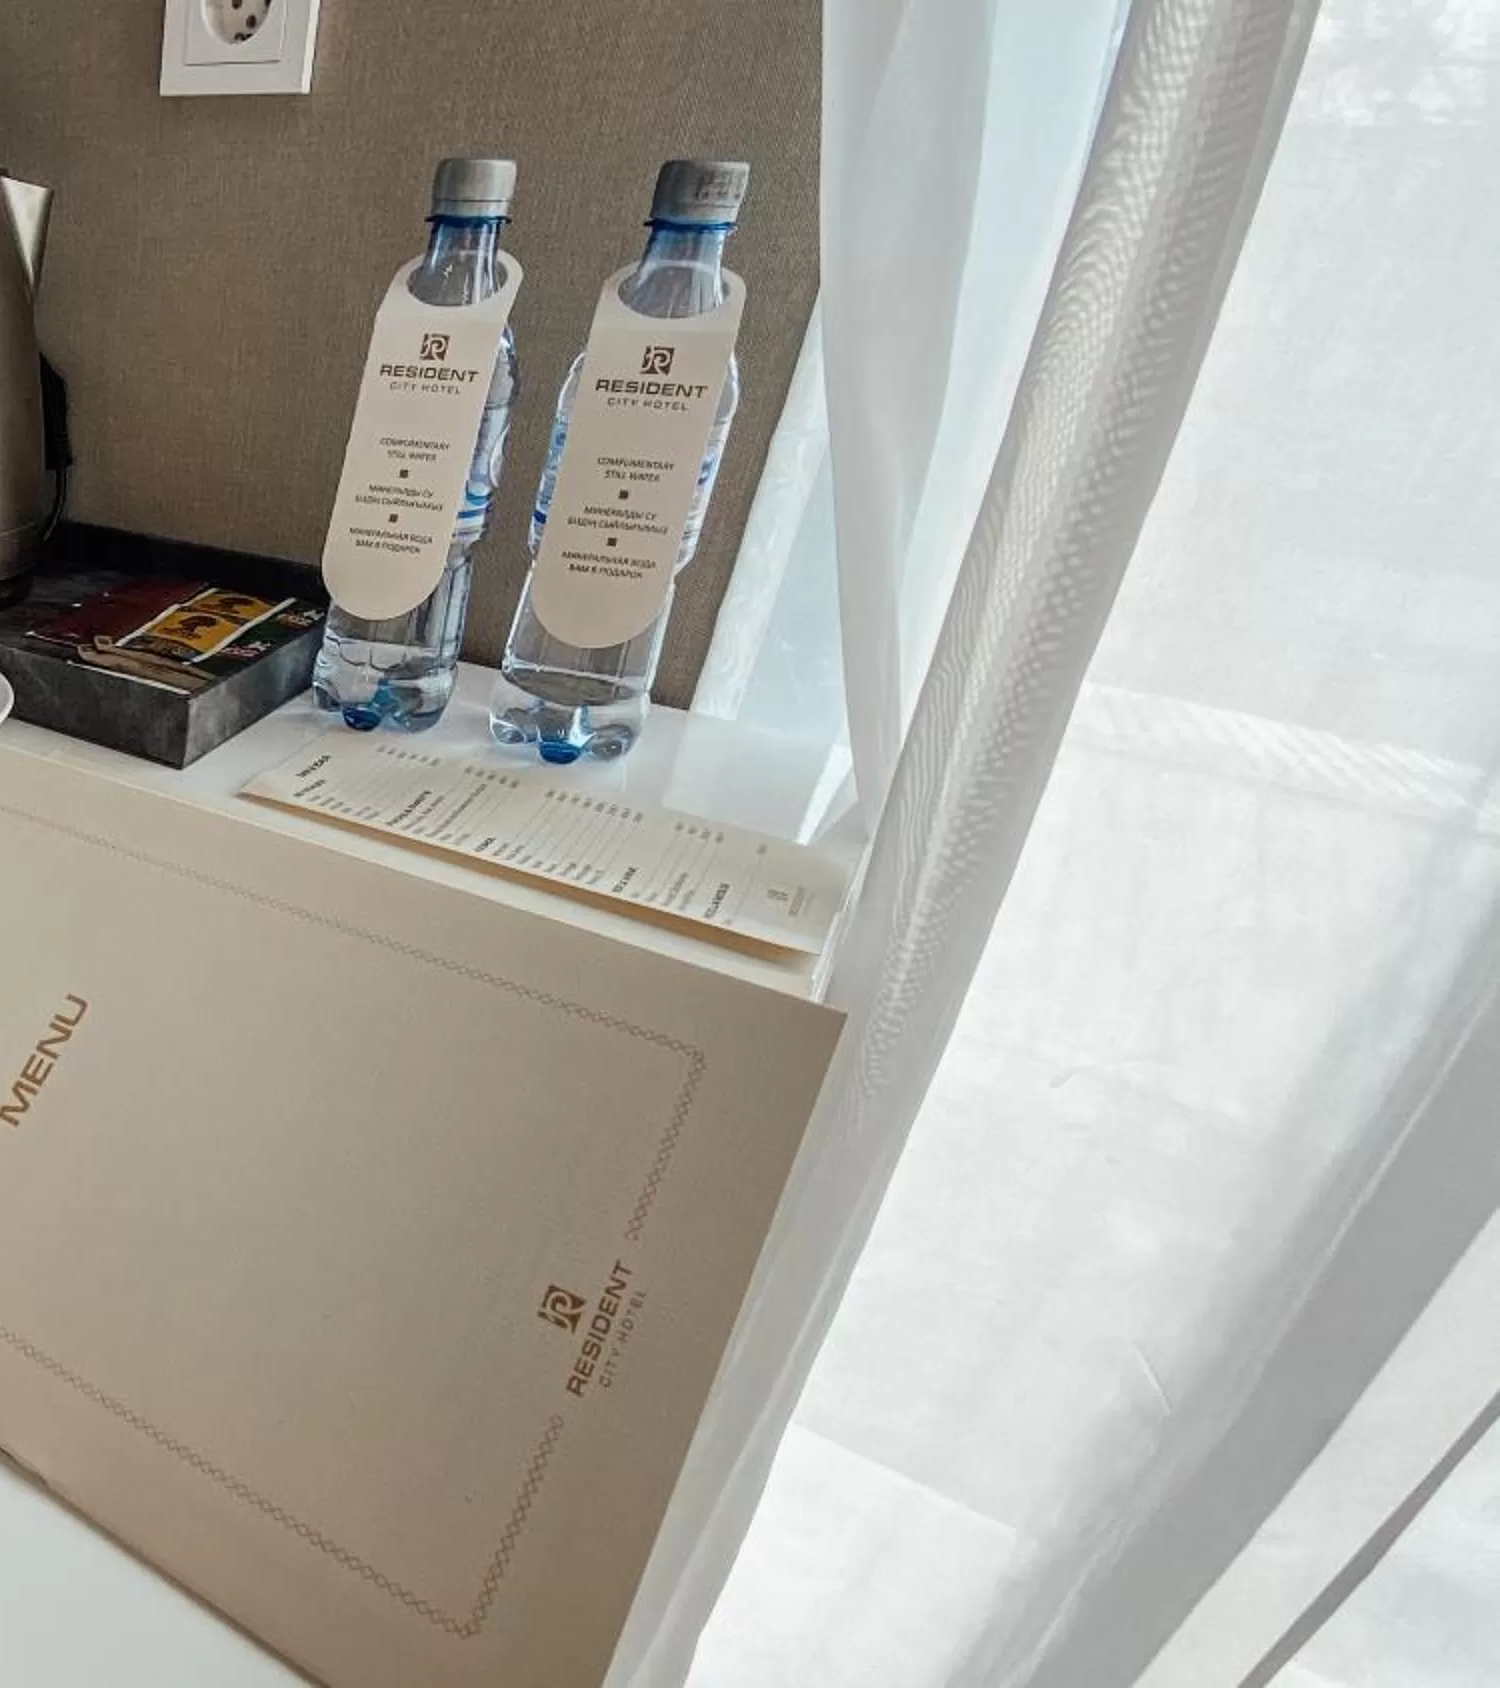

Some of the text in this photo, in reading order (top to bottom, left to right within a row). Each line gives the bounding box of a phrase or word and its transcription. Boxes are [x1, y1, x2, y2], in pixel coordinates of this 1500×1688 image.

[380, 364, 479, 382] RESIDENT
[389, 381, 460, 395] CITY HOTEL
[595, 378, 708, 398] RESIDENT
[607, 397, 689, 411] CITY HOTEL
[616, 1291, 647, 1344] HOTEL
[566, 1259, 633, 1397] RESIDENT
